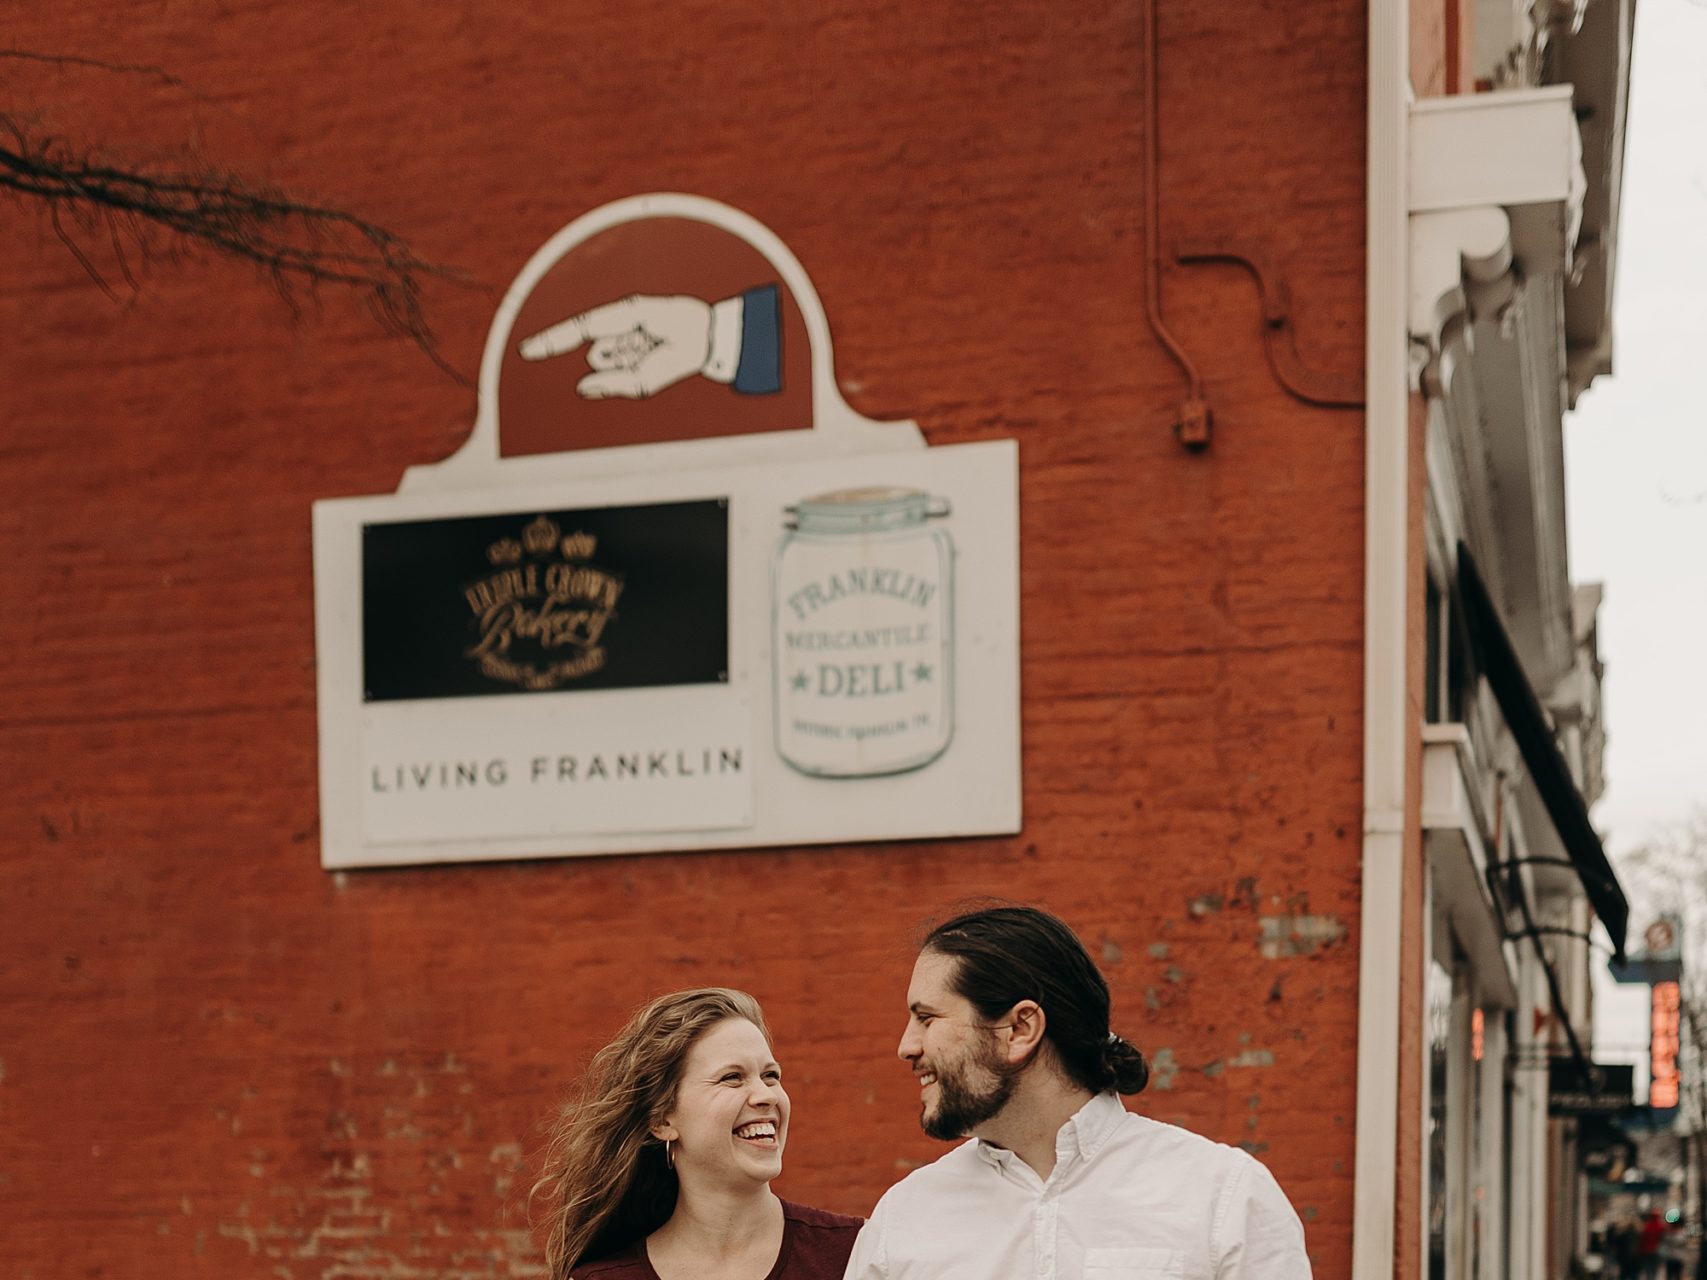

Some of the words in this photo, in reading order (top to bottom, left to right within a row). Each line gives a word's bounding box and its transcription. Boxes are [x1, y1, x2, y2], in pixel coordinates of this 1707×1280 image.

[787, 567, 936, 620] FRANKLIN
[817, 661, 905, 697] DELI
[372, 758, 509, 793] LIVING
[531, 747, 744, 783] FRANKLIN
